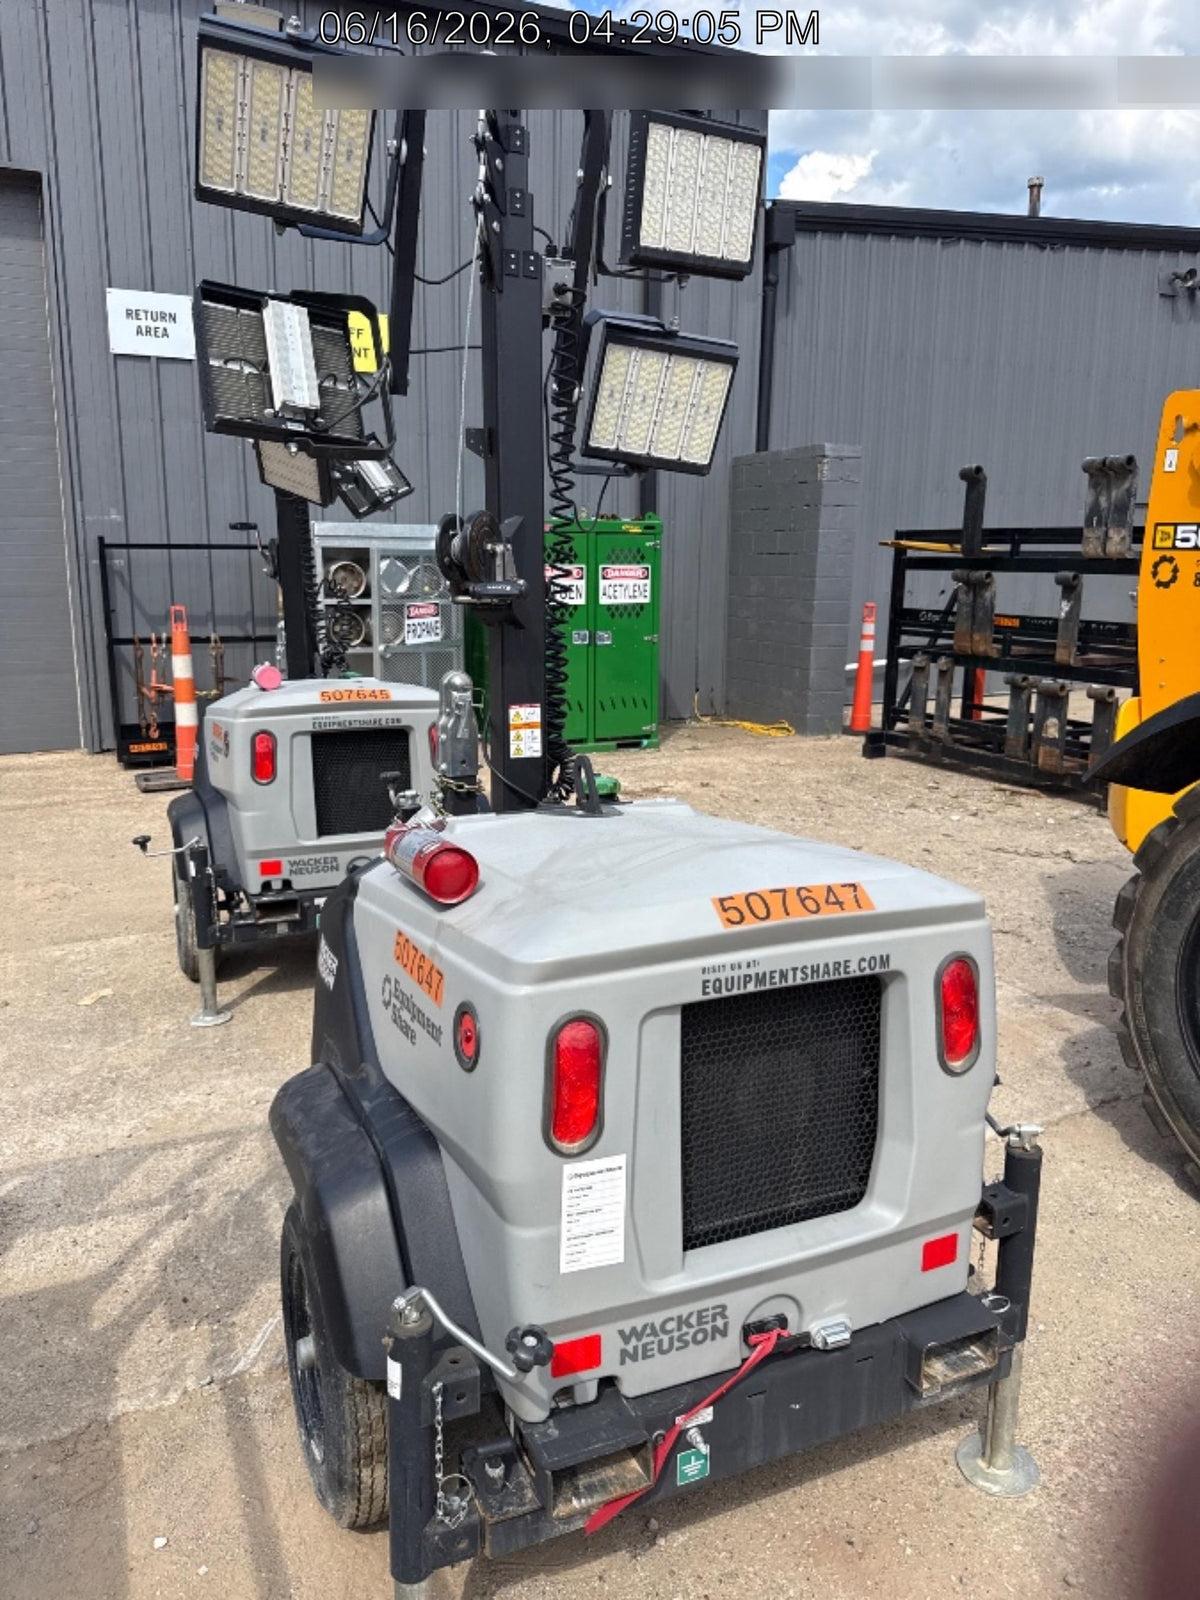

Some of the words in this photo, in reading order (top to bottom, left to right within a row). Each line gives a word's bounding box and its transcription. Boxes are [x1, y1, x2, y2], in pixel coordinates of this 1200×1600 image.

[125, 308, 177, 324] RETURN
[136, 325, 169, 339] AREA
[1174, 524, 1200, 548] 5
[602, 583, 648, 600] ACETYLENE
[407, 620, 439, 640] PROPANE
[320, 690, 391, 701] 507645
[288, 856, 338, 868] WACKER
[289, 864, 340, 876] NEUSON
[718, 883, 863, 925] 507647
[395, 930, 444, 1002] 507647
[701, 965, 726, 975] VISIT
[730, 962, 742, 971] US
[701, 953, 890, 996] EQUIPMENTSHARE.COM
[394, 977, 443, 1047] Equipment
[391, 1002, 416, 1046] Share
[617, 1304, 729, 1345] WACKER
[619, 1320, 730, 1366] NEUSON
